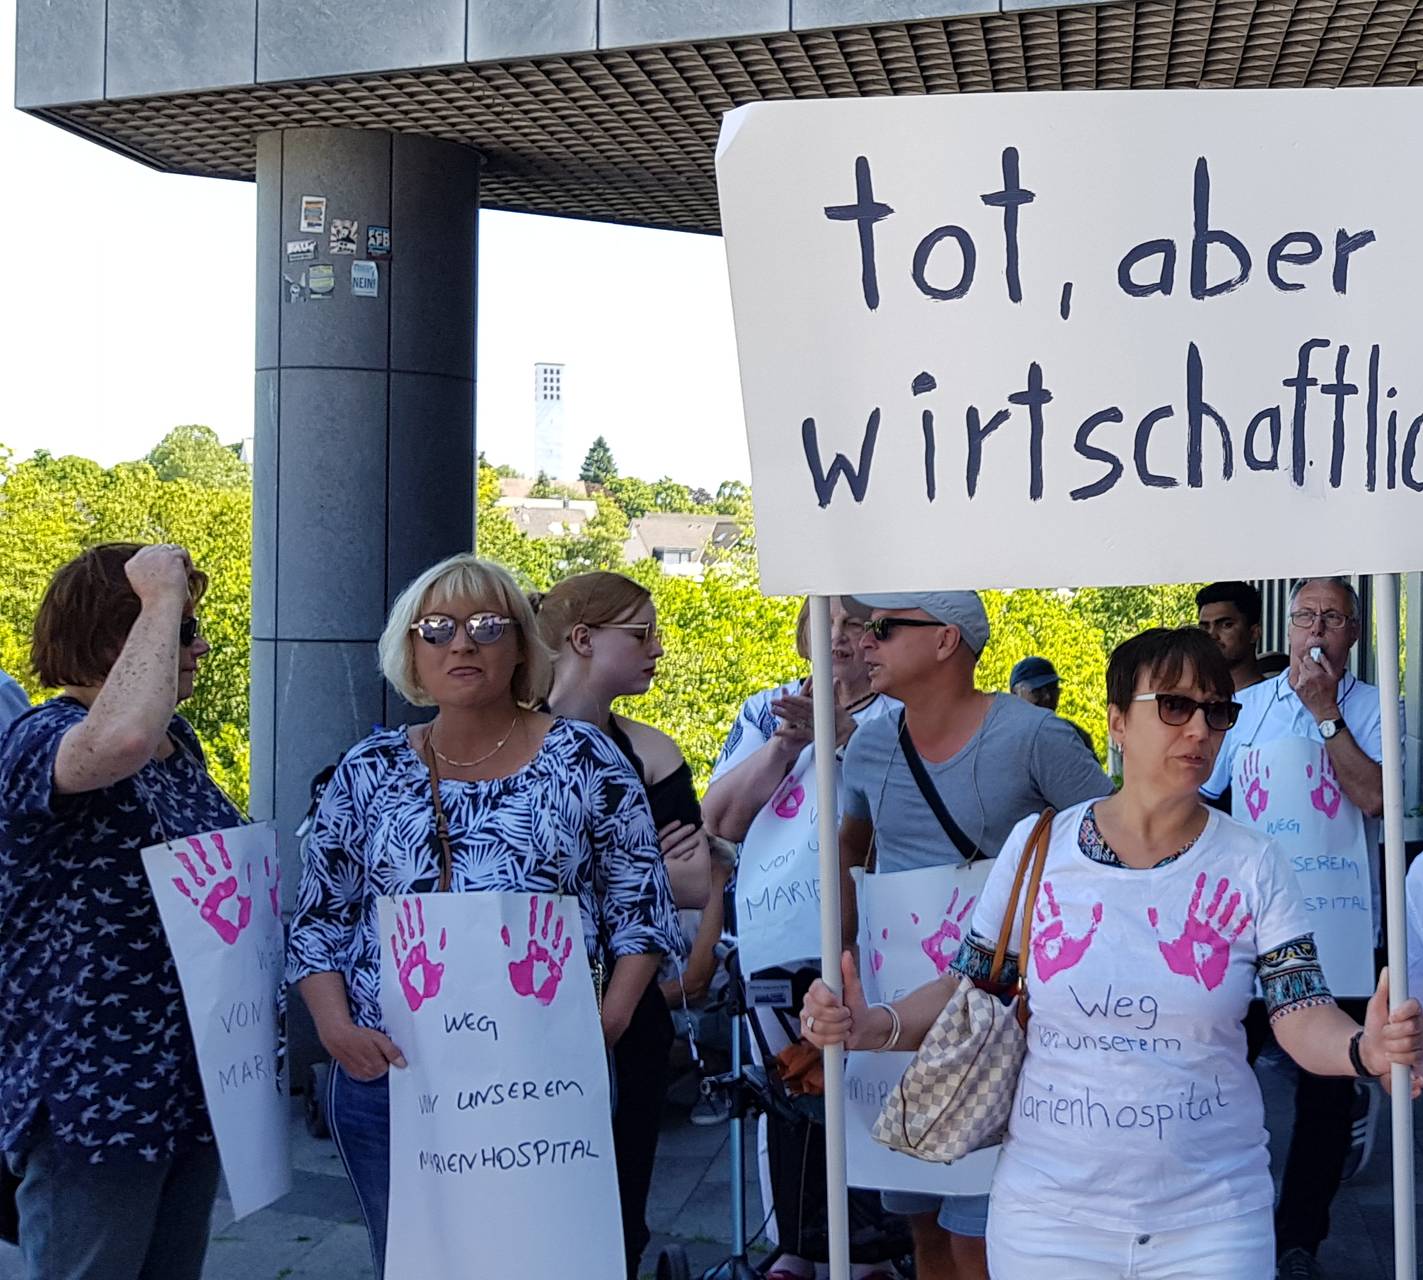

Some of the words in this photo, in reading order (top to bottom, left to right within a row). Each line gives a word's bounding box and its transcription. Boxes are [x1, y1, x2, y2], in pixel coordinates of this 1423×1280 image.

[824, 146, 1074, 320] tot,
[1117, 156, 1377, 301] aber
[1266, 818, 1300, 834] WEG
[1068, 984, 1158, 1030] Weg
[444, 1013, 498, 1041] WEG
[1065, 1036, 1181, 1052] unserem
[456, 1080, 584, 1111] UNSEREM
